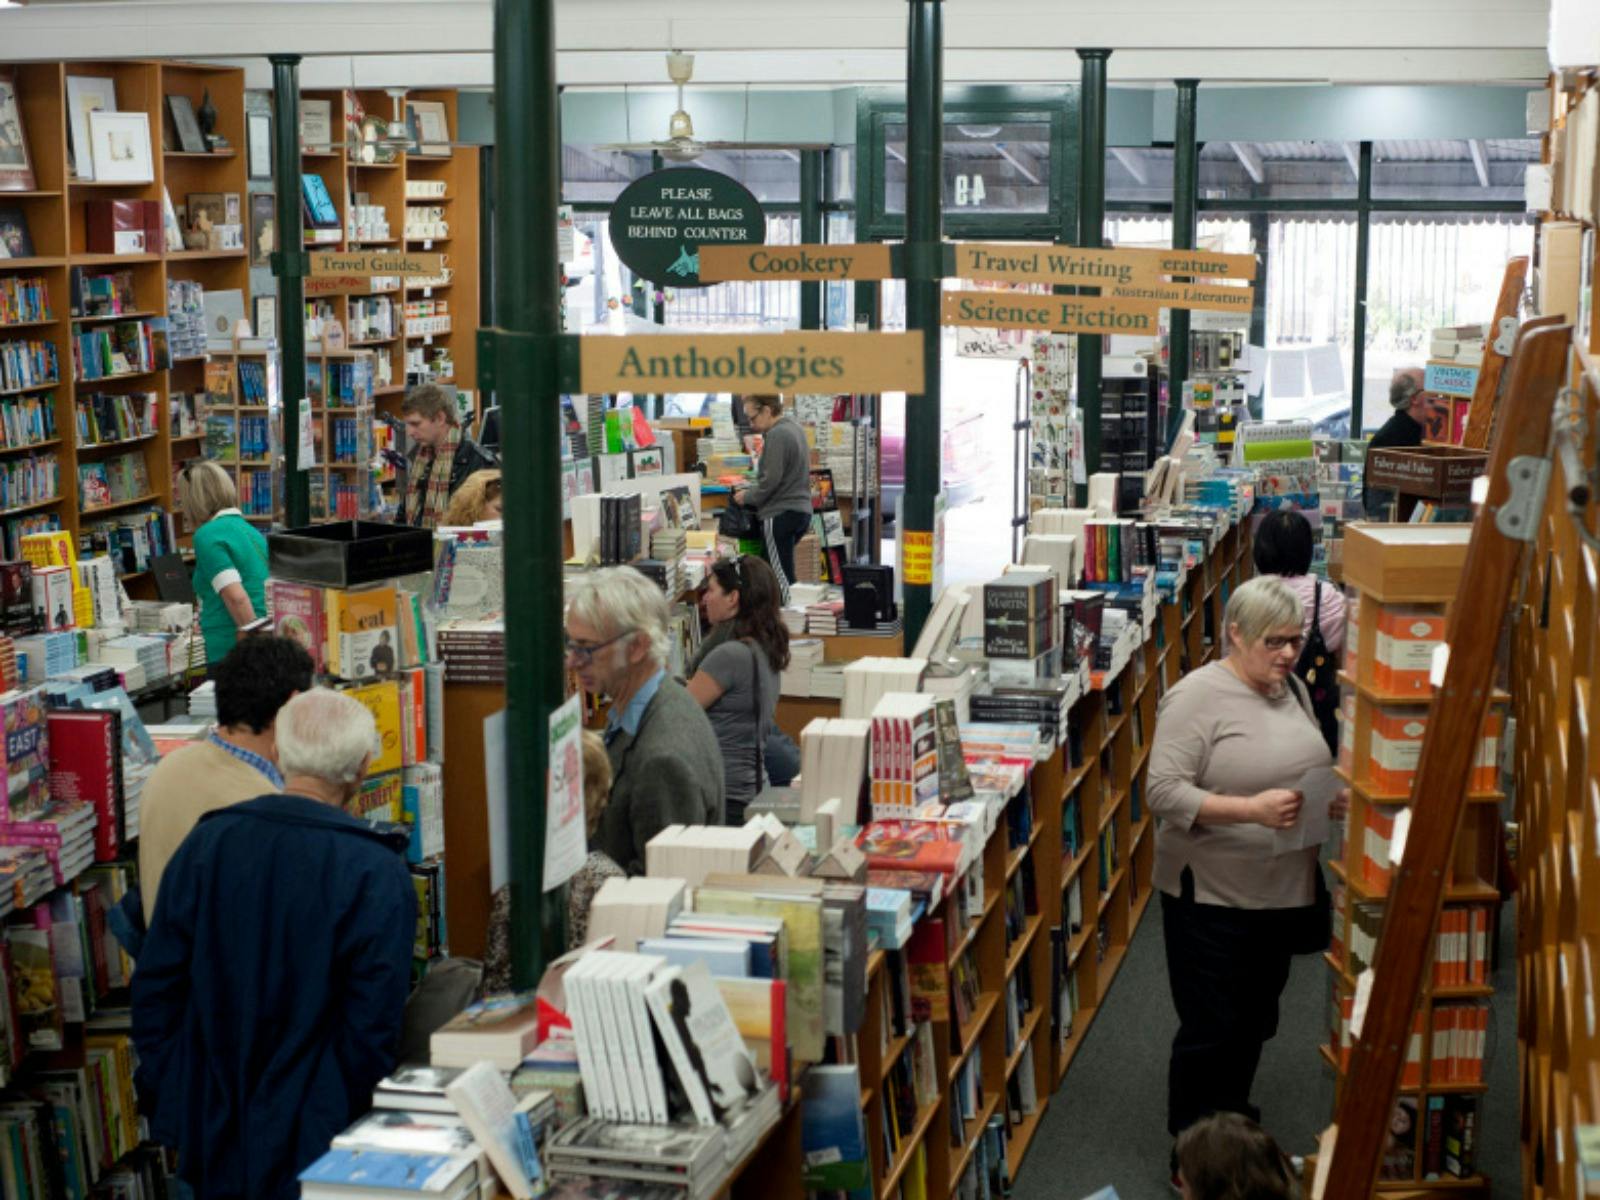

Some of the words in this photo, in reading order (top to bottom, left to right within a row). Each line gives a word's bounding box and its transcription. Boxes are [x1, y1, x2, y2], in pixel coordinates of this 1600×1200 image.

[661, 188, 712, 200] PLEASE
[630, 206, 674, 219] LEAVE
[678, 207, 704, 220] ALL
[708, 208, 744, 221] BAGS
[628, 225, 677, 238] BEHIND
[684, 227, 747, 240] COUNTER
[320, 256, 365, 271] Travel
[371, 257, 421, 272] Guides
[749, 251, 854, 276] Cookery
[969, 250, 1039, 273] Travel
[1048, 254, 1132, 283] Writing
[1160, 259, 1228, 273] erature
[305, 278, 337, 292] opics
[1112, 286, 1179, 300] Australian
[1184, 288, 1249, 304] Literature
[958, 298, 1049, 324] Science
[1060, 303, 1149, 329] Fiction
[617, 345, 844, 388] Anthologies
[358, 609, 385, 628] eat
[9, 728, 38, 758] EAST
